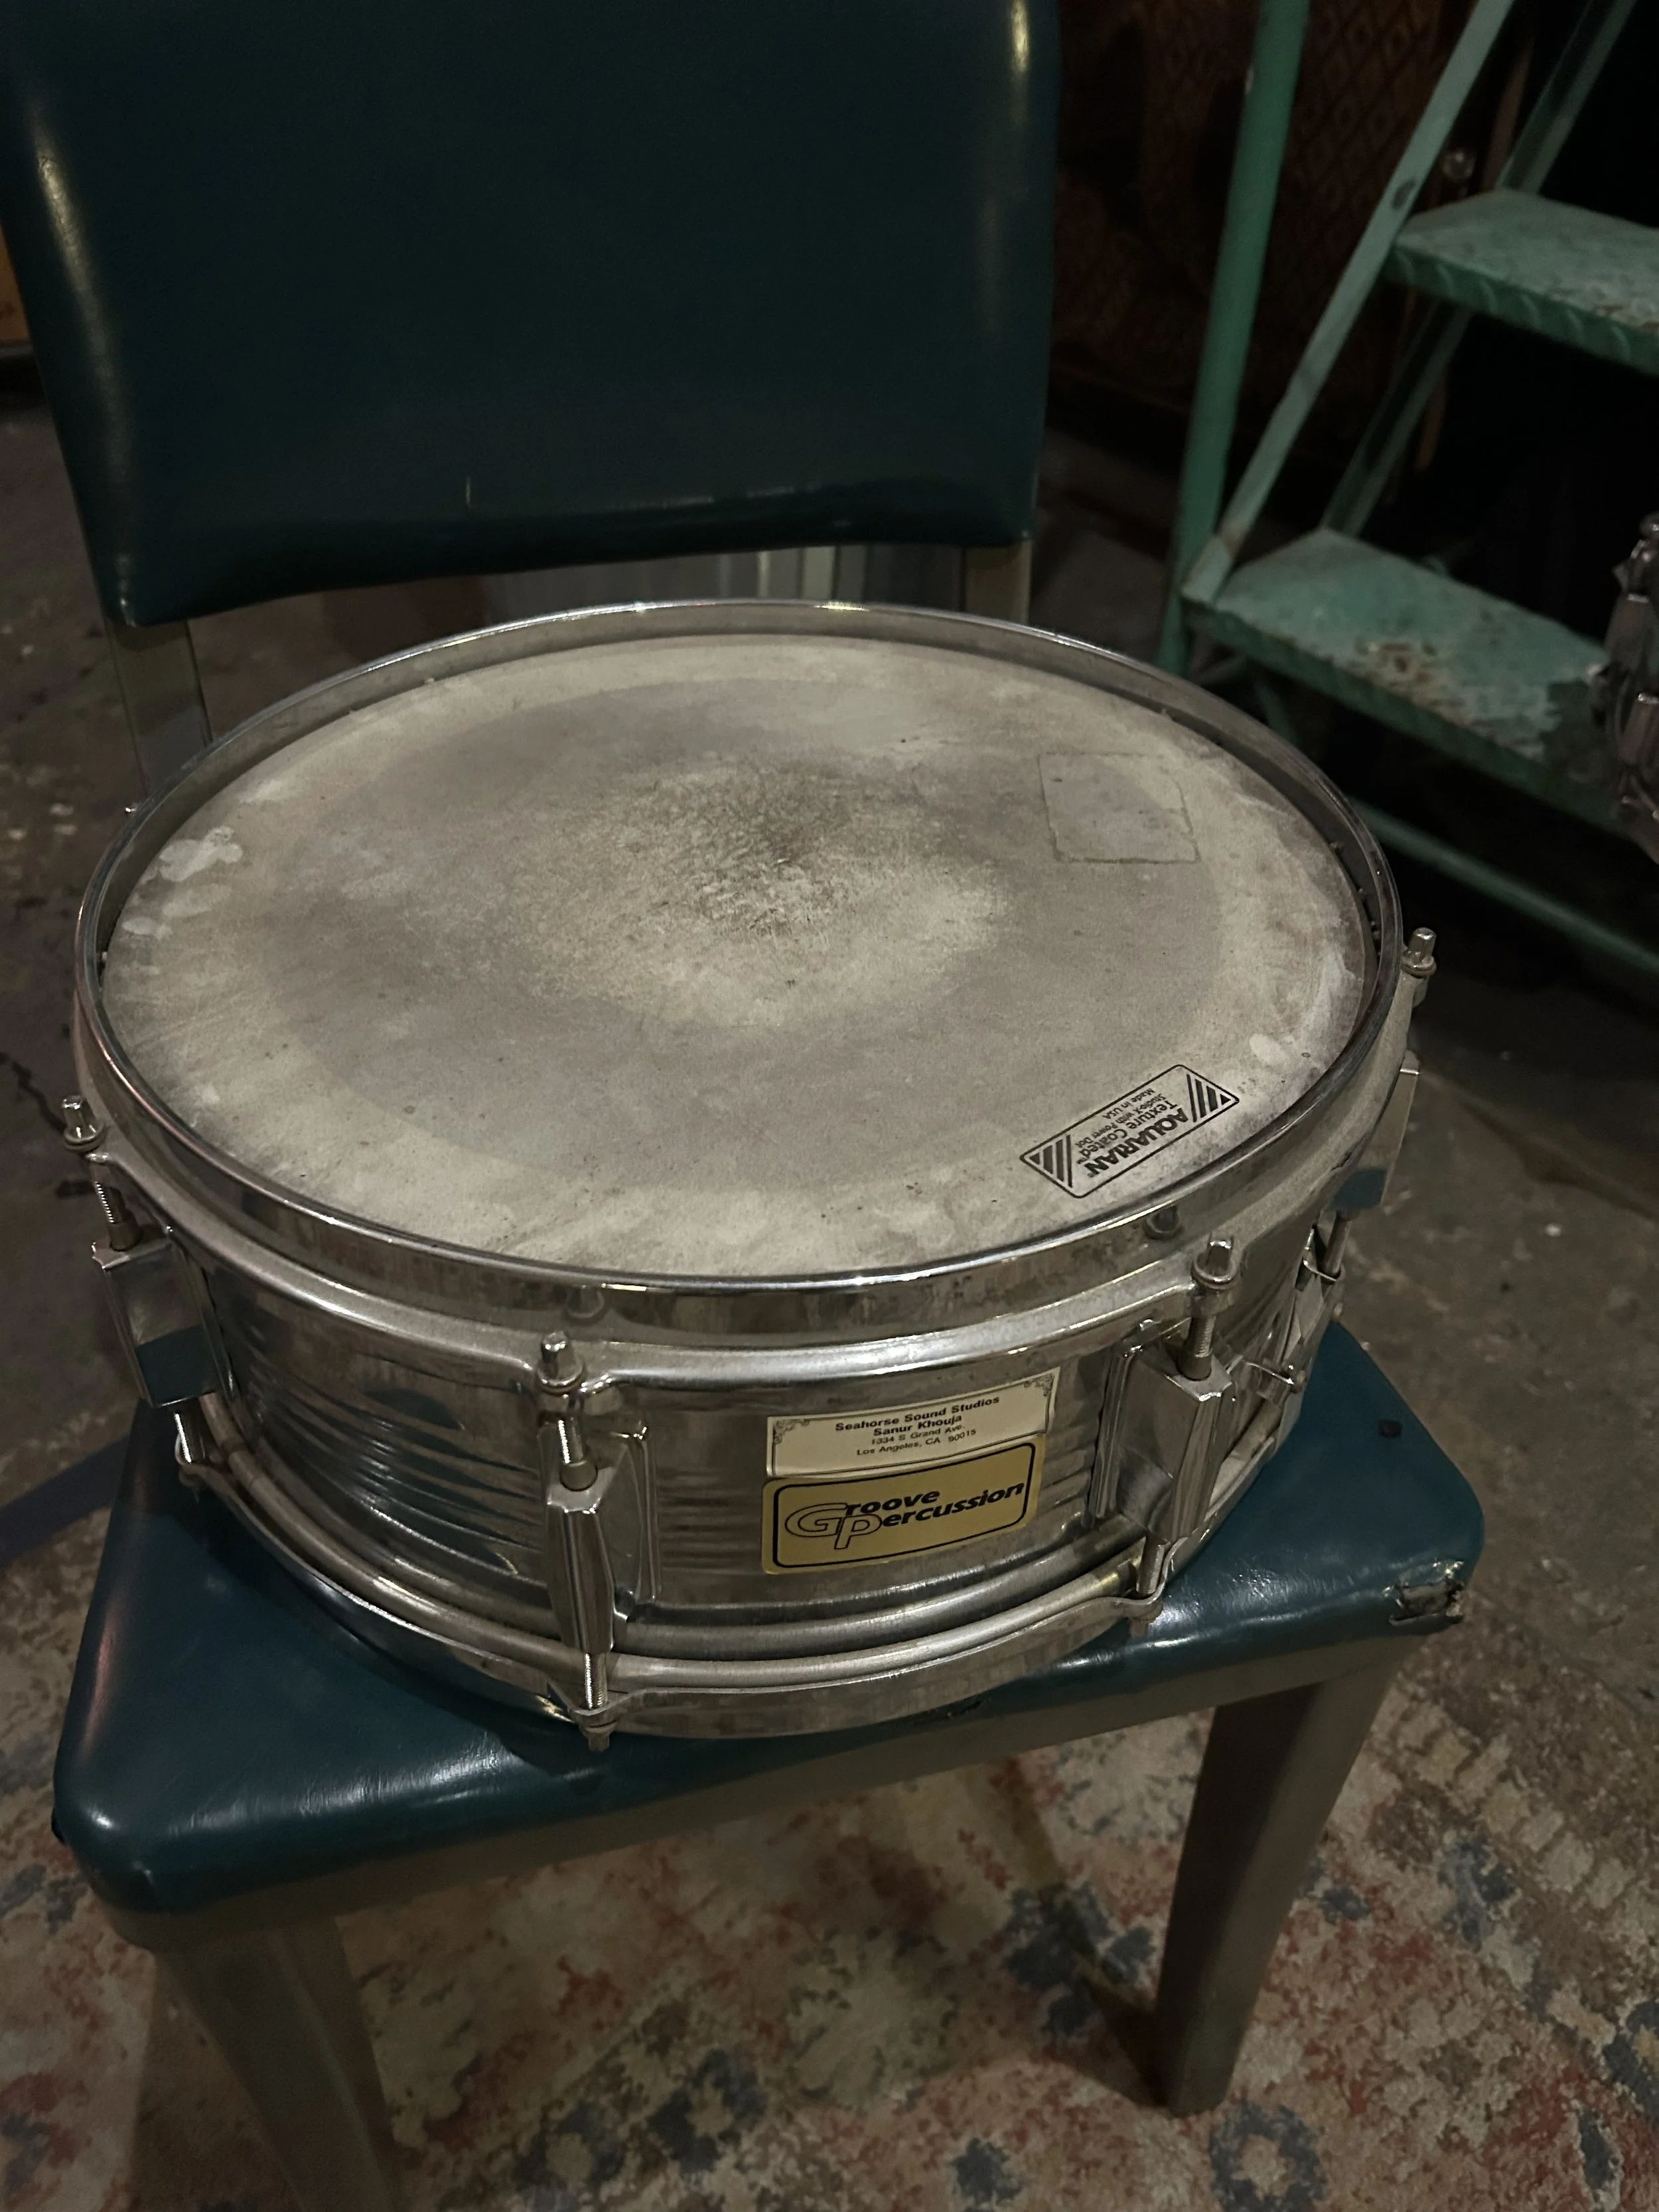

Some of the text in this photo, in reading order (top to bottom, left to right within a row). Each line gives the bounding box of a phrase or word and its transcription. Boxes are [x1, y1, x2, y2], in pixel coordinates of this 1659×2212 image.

[1102, 1088, 1155, 1119] Made in USA
[1125, 1100, 1178, 1130] Texture
[1115, 1110, 1134, 1124] with
[1074, 1137, 1092, 1148] Dot
[1091, 1123, 1118, 1140] Power
[835, 1397, 999, 1431] Seahorse Sound Studios
[873, 1415, 962, 1436] Sanur Khouja
[871, 1436, 895, 1445] 1334
[910, 1428, 941, 1439] Grand
[879, 1441, 922, 1452] Angeles,
[948, 1428, 976, 1442] 90015
[784, 1491, 940, 1538] Groove
[833, 1482, 1025, 1550] Percussion
